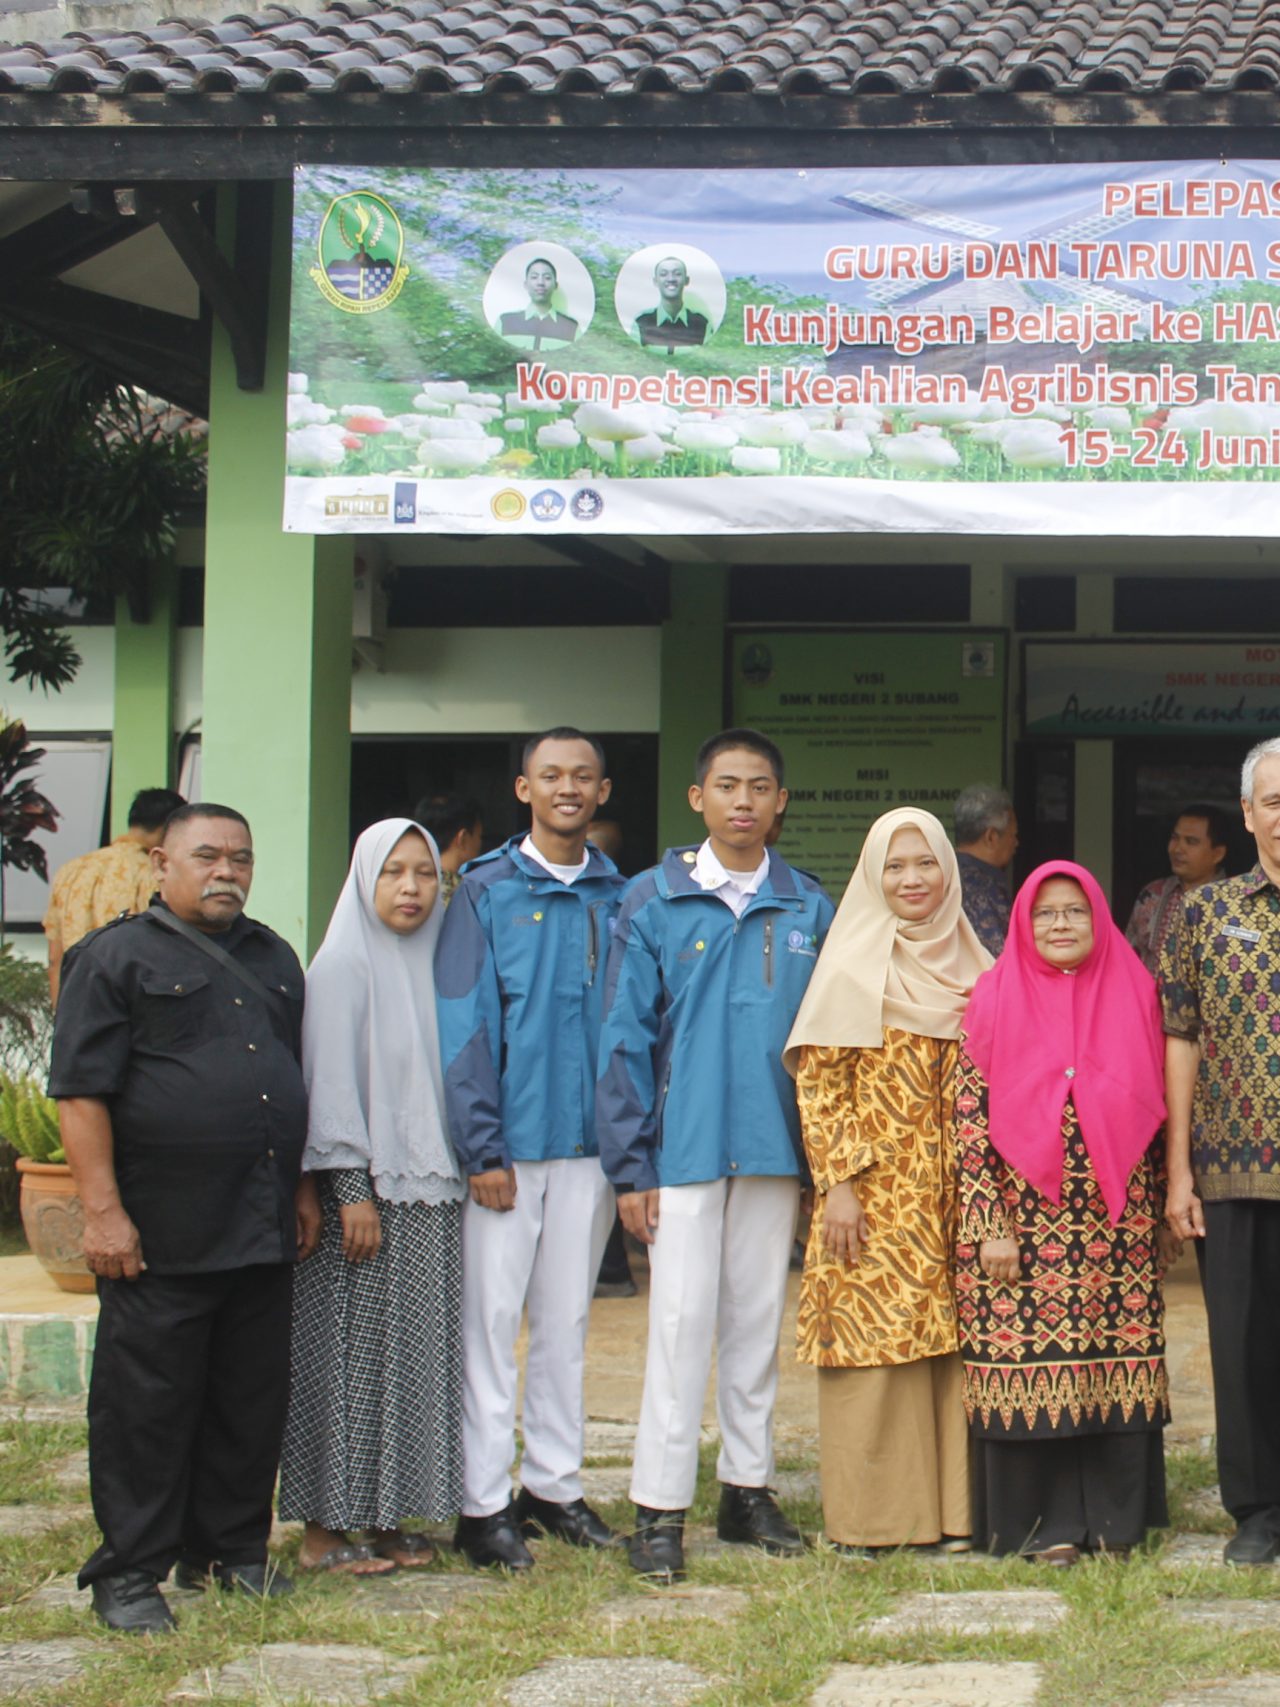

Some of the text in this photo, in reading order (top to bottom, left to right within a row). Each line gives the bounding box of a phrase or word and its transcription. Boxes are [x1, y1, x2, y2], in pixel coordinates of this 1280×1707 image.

[828, 245, 949, 280] GURU
[966, 243, 1057, 279] DAN
[1071, 242, 1254, 279] TARUNA
[746, 305, 974, 353] Kunjungan
[990, 304, 1138, 350] Belajar
[1153, 304, 1201, 340] ke
[518, 366, 769, 409] Kompetensi
[784, 367, 966, 405] Keahlian
[981, 367, 1196, 413] Agribisnis
[1059, 429, 1186, 466] 15-24
[1199, 428, 1280, 467] Juni
[854, 671, 885, 685] VISI
[1166, 673, 1207, 687] SMK
[780, 693, 960, 705] SMK NEGERI 2 SUBANG
[1061, 693, 1183, 724] Accessible
[1193, 695, 1246, 723] and
[857, 768, 888, 781] MISI
[822, 789, 878, 801] NEGERI
[885, 789, 893, 801] 2
